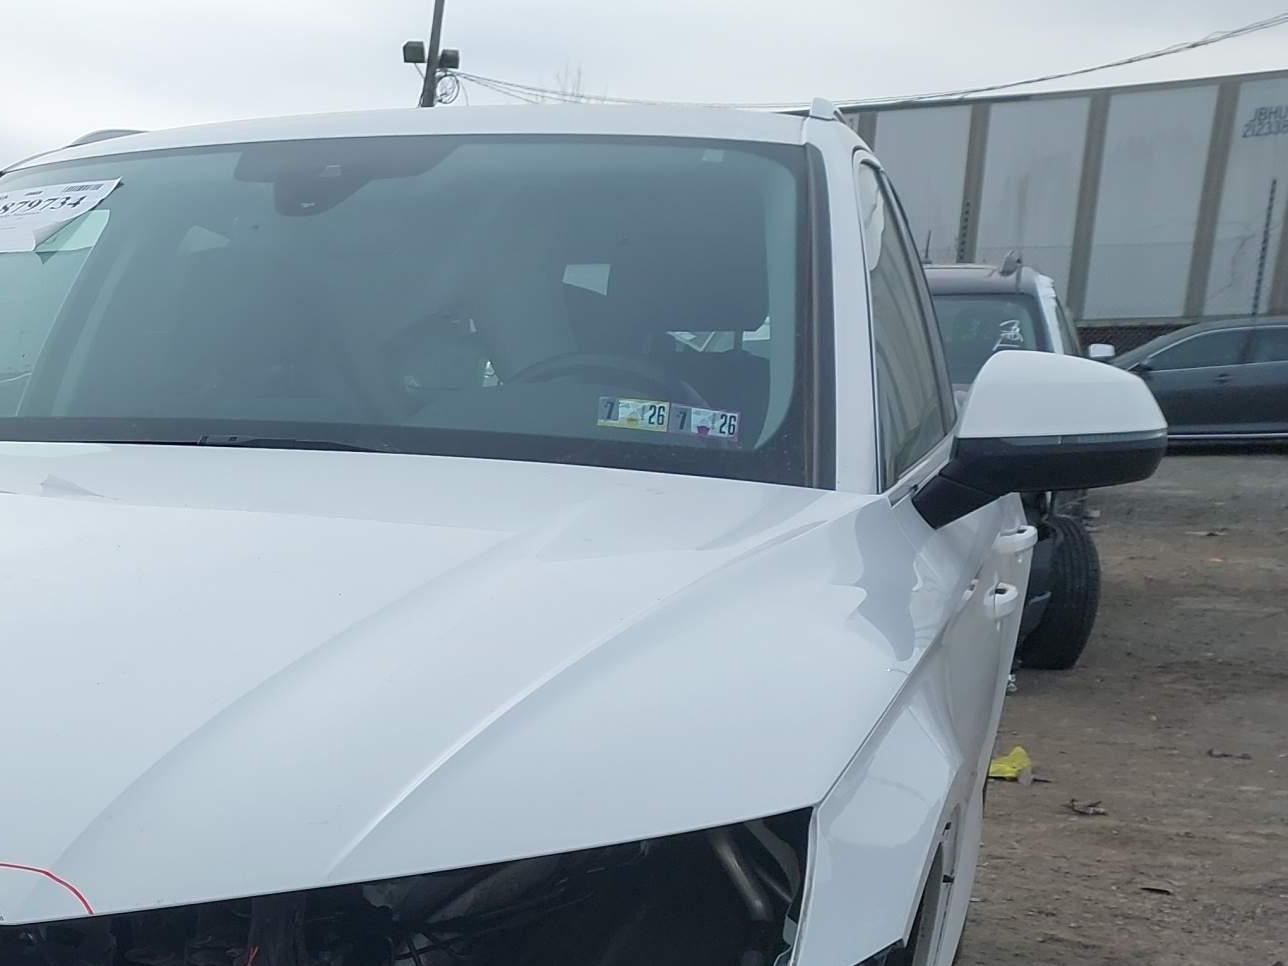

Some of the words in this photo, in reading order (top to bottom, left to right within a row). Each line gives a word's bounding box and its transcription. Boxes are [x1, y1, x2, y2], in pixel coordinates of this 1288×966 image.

[603, 401, 615, 420] 7
[647, 404, 666, 425] 26
[677, 411, 687, 430] 7
[719, 413, 737, 435] 26
